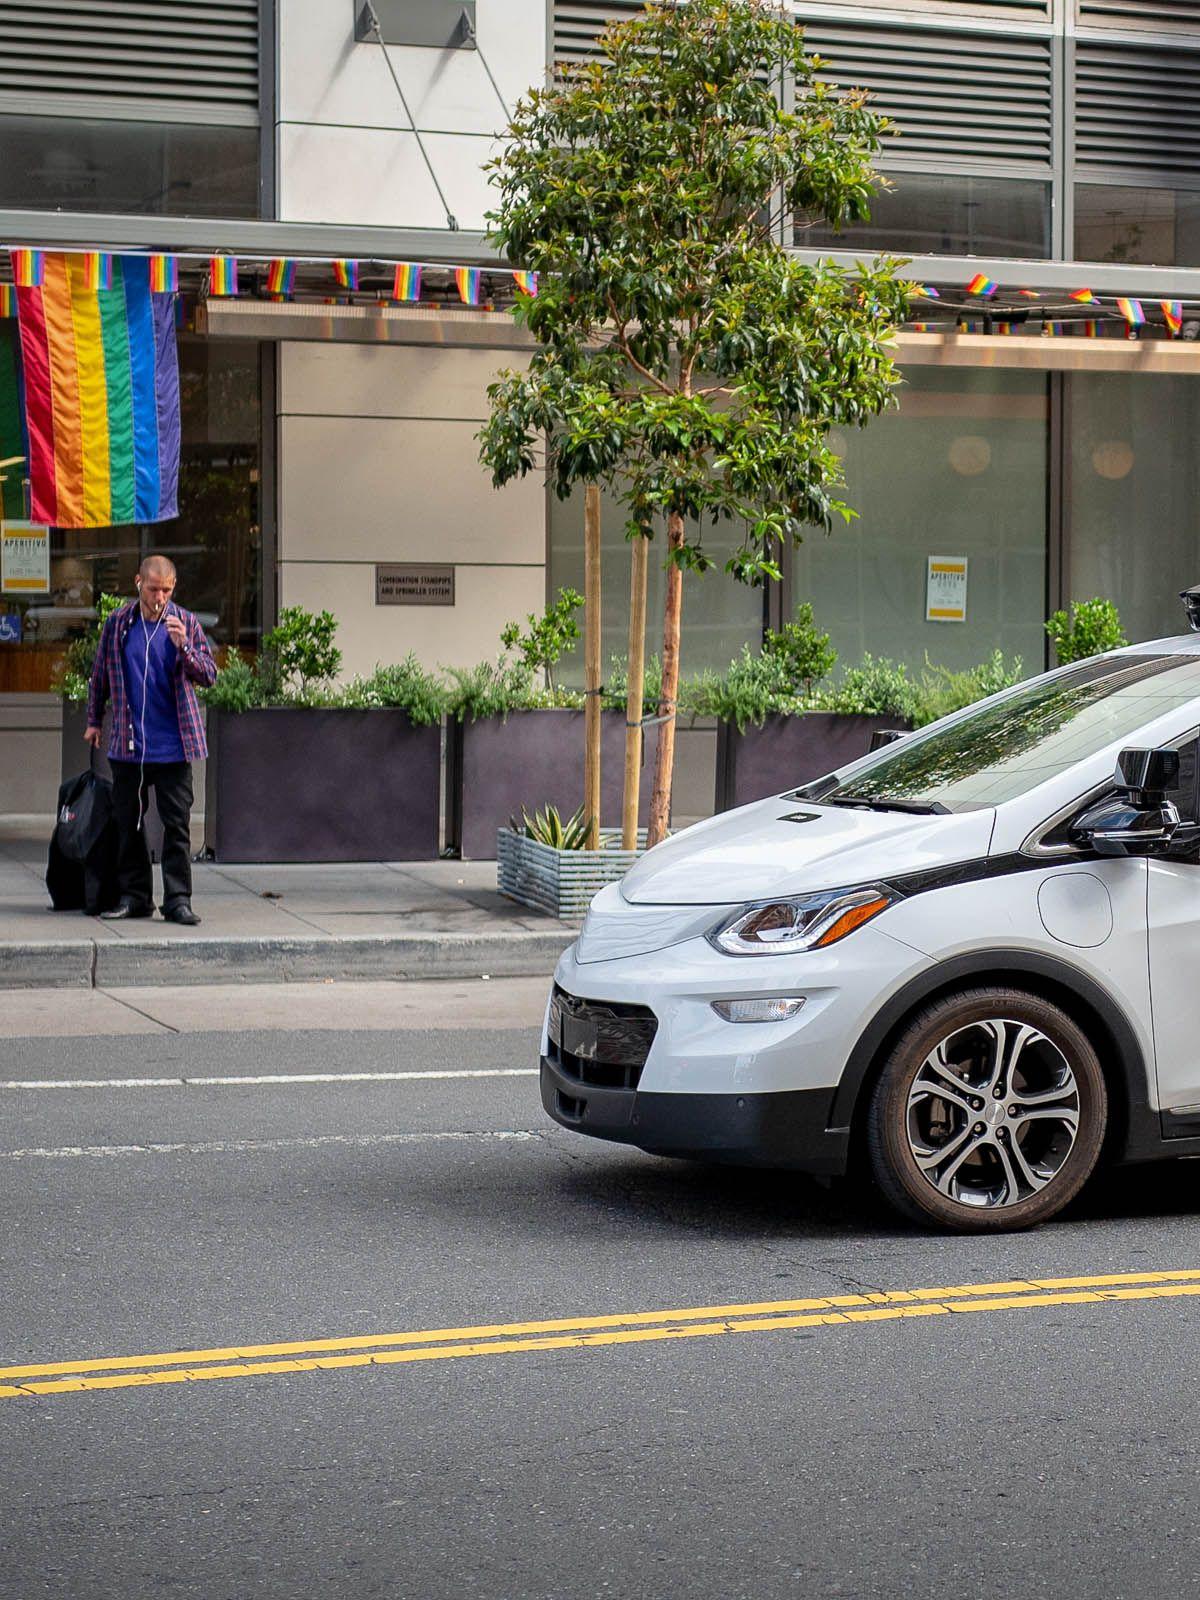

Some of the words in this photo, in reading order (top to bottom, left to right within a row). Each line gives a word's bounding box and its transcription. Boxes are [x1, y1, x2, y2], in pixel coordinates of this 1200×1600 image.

[379, 576, 419, 585] COMBINATION
[421, 576, 451, 585] STANDPIPE
[381, 587, 394, 595] AND
